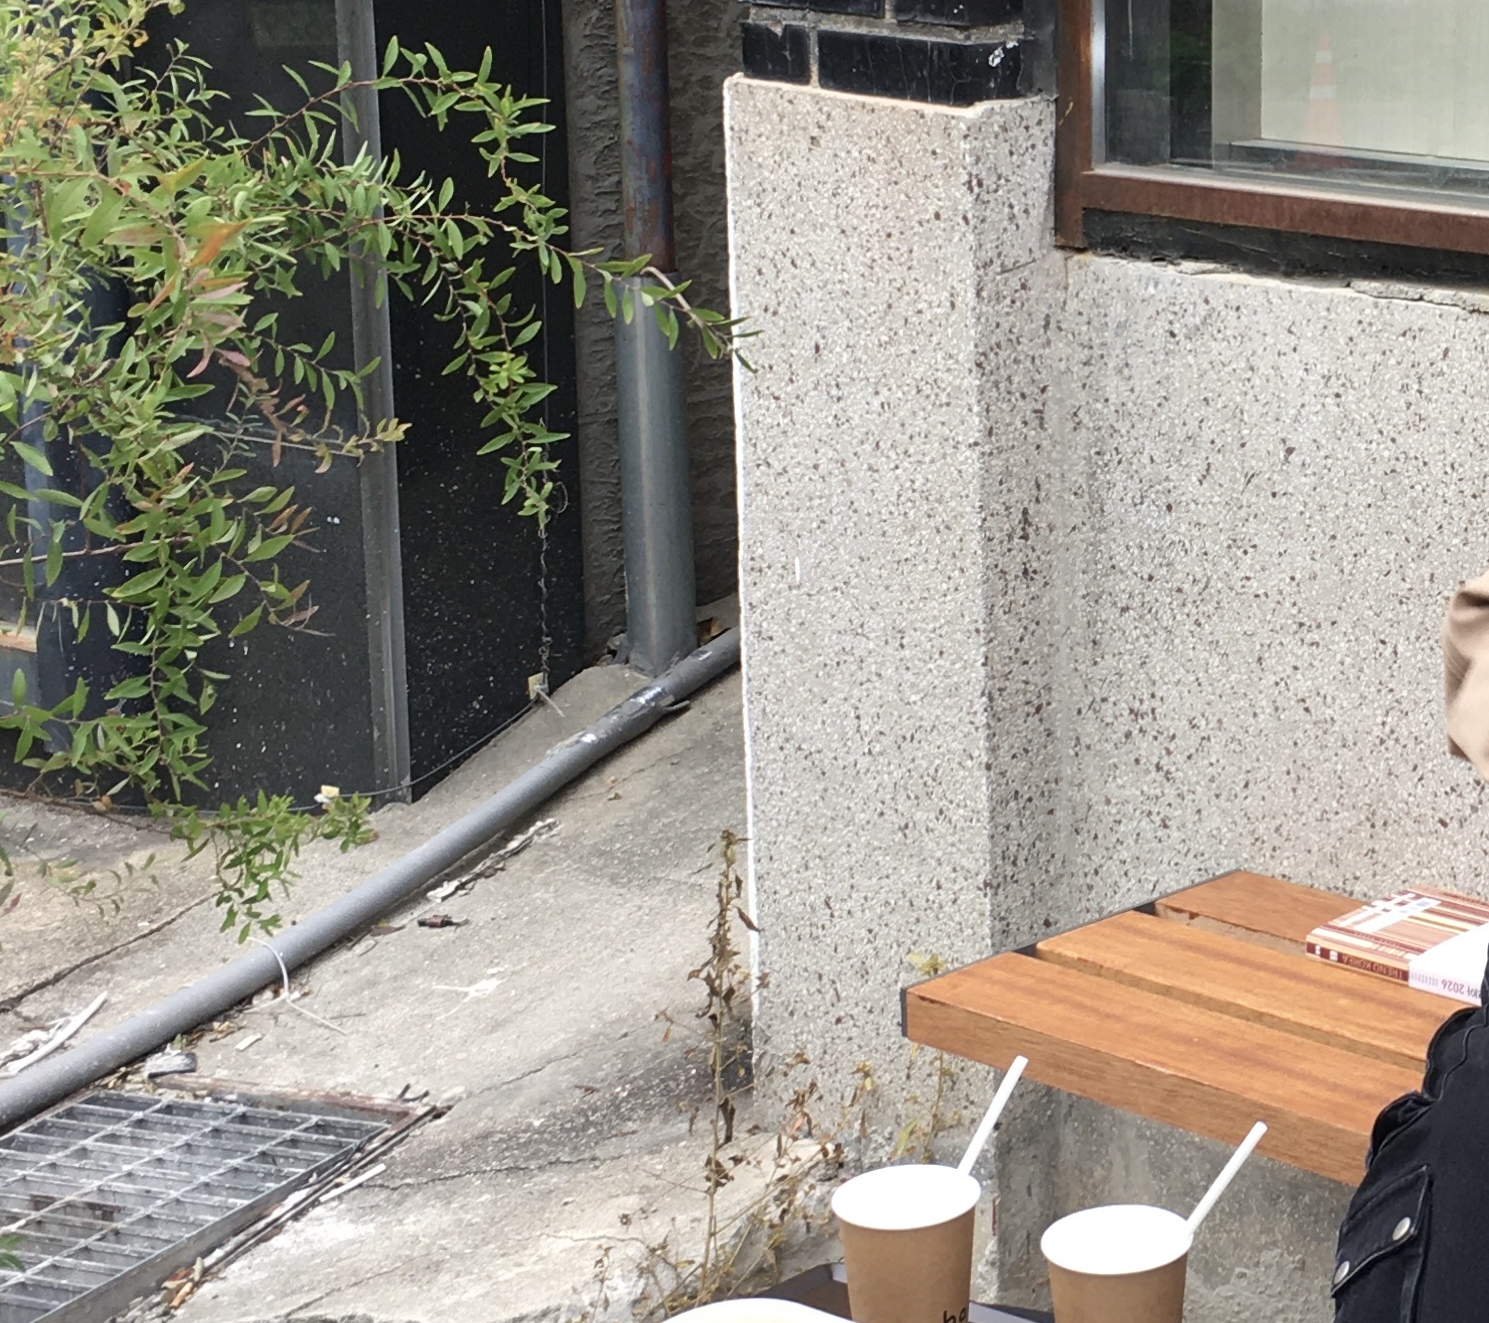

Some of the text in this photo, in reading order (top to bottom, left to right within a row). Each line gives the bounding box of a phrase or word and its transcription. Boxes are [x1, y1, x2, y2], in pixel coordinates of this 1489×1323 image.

[1341, 953, 1372, 972] KOREA
[1372, 962, 1404, 980] TREND
[1441, 979, 1465, 996] 2026
